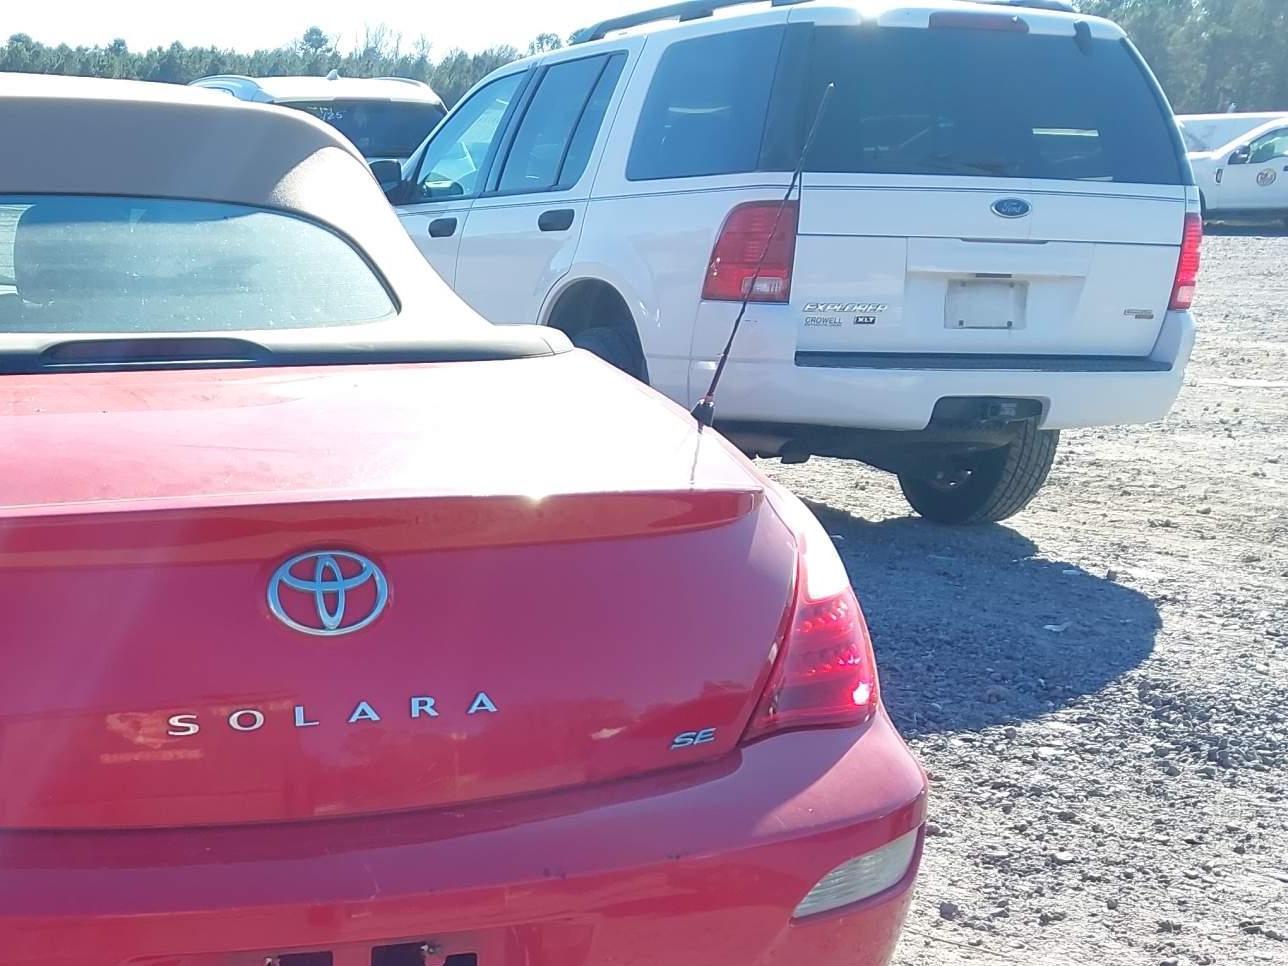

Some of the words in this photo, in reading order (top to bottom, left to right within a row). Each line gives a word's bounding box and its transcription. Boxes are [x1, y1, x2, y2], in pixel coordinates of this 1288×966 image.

[803, 303, 888, 313] EXPLORER
[855, 316, 875, 324] XLT
[166, 691, 499, 736] SOLARA
[669, 727, 717, 751] SE
